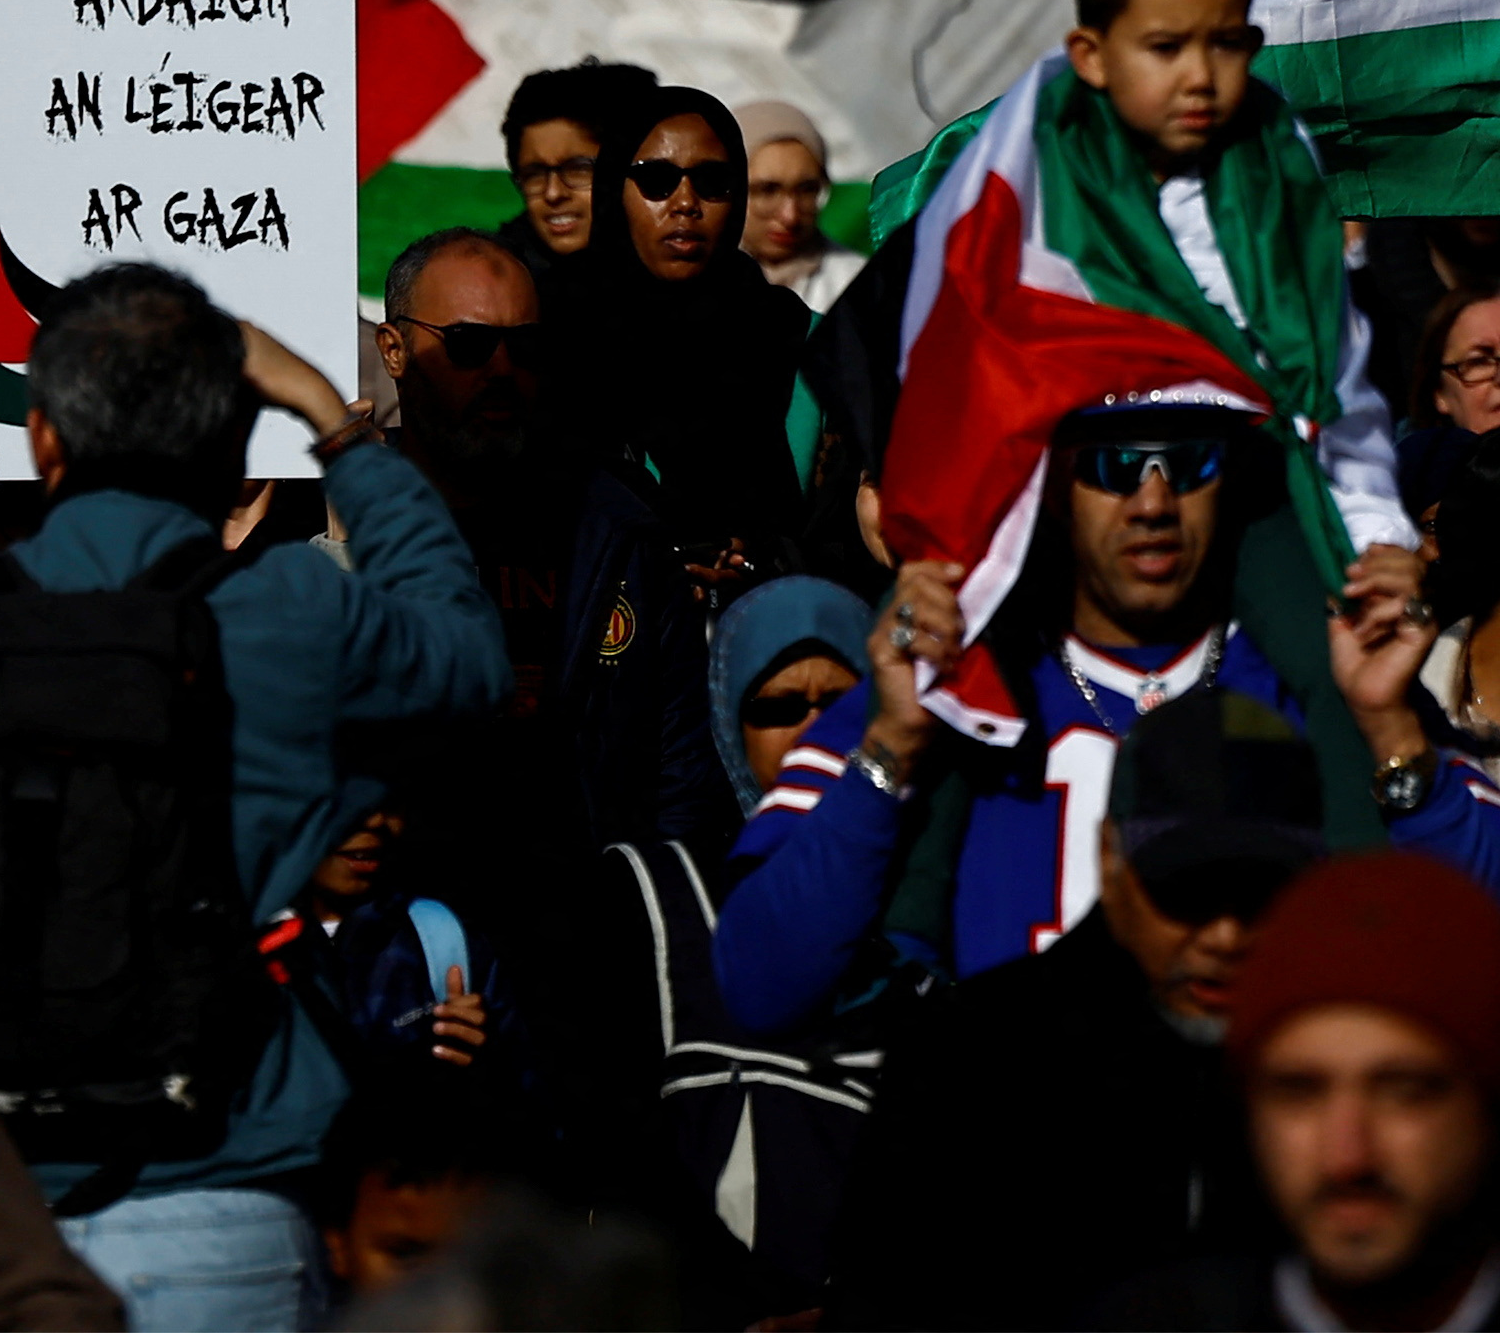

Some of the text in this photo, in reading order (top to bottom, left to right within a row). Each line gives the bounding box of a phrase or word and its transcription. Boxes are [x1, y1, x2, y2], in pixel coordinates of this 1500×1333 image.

[45, 52, 325, 141] AN LÉIGEAR
[81, 184, 290, 251] AR GAZA
